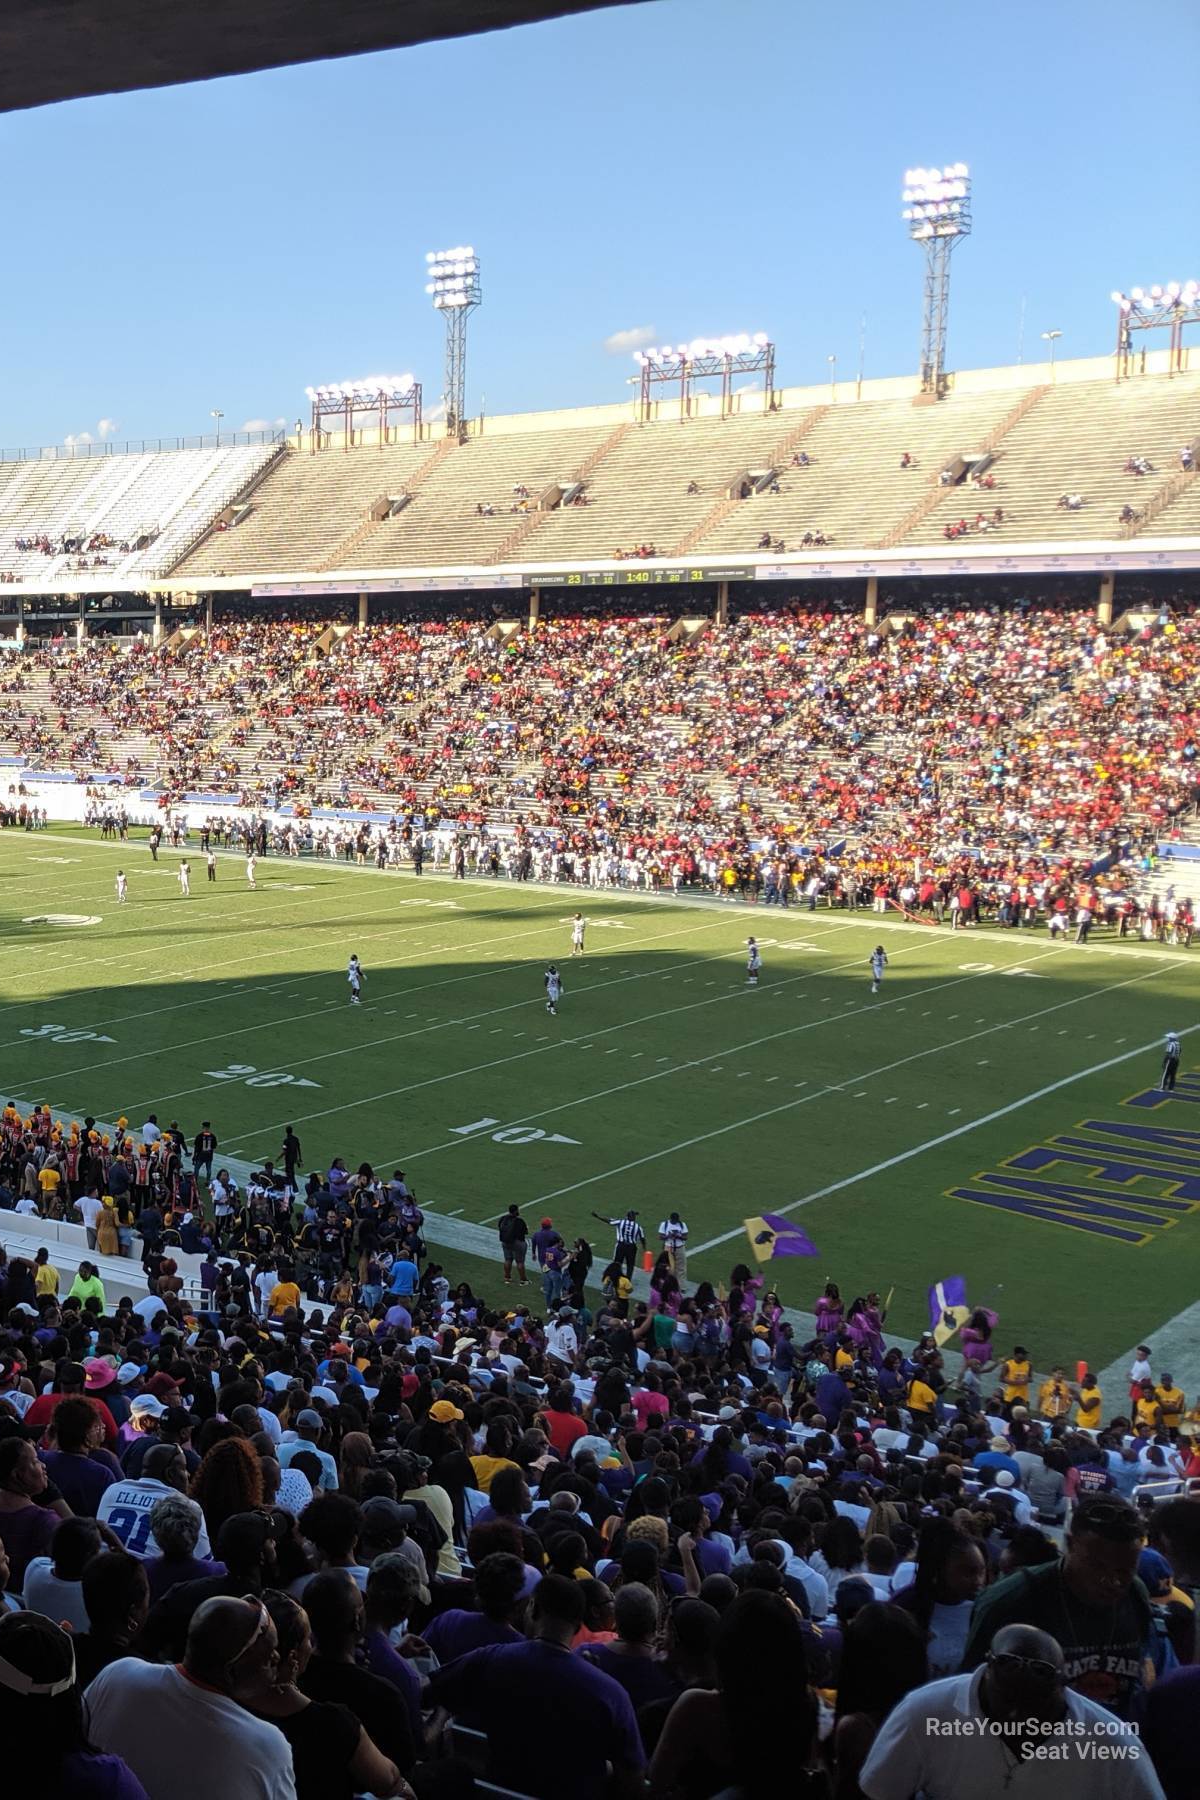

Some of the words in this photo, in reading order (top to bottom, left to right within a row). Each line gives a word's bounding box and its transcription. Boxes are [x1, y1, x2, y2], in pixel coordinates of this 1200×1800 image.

[568, 575, 581, 584] 23
[627, 573, 649, 583] 1:40
[691, 571, 704, 581] 31
[19, 1024, 98, 1043] 30
[202, 1064, 295, 1087] 20
[448, 1117, 546, 1144] 10
[108, 1508, 152, 1554] 21
